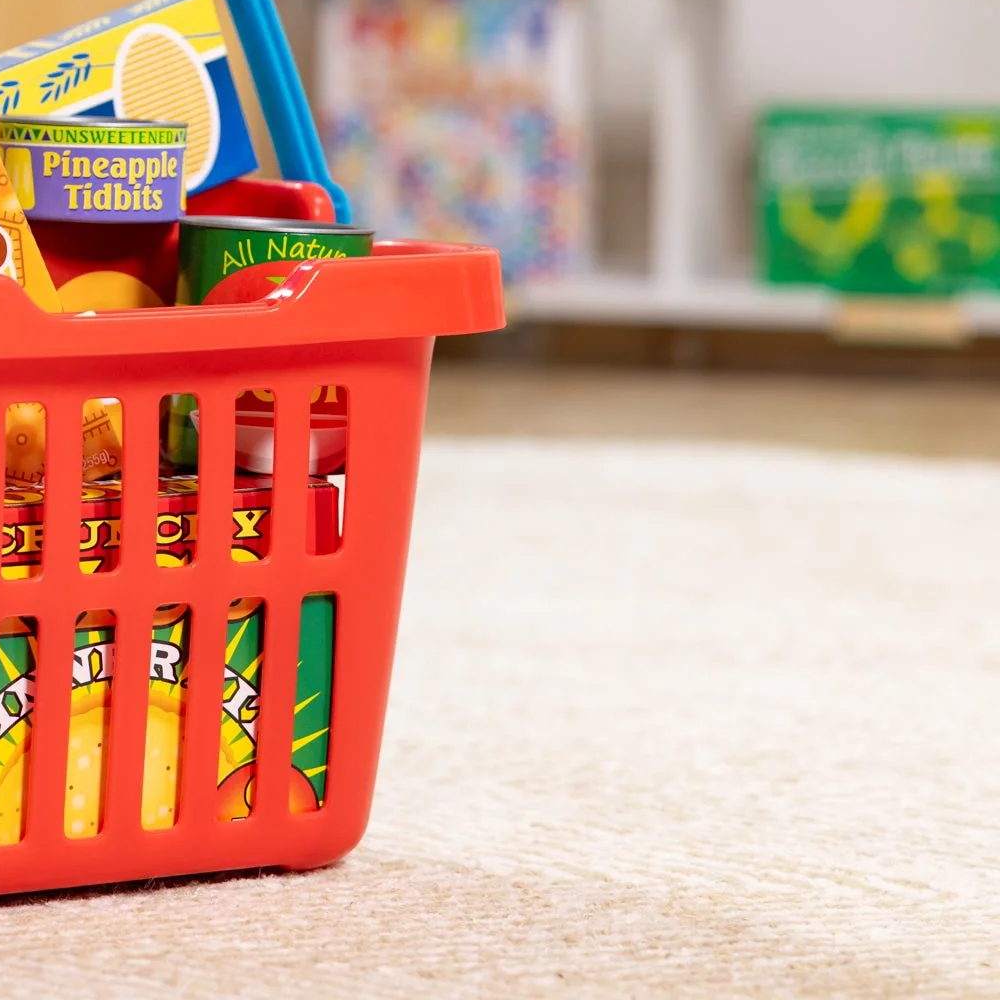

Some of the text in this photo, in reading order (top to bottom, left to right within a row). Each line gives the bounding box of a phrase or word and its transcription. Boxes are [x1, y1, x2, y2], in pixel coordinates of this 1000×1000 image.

[52, 129, 174, 145] UNSWEETENED
[42, 149, 178, 185] Pineapple
[63, 182, 164, 212] Tidbits
[222, 238, 255, 275] All
